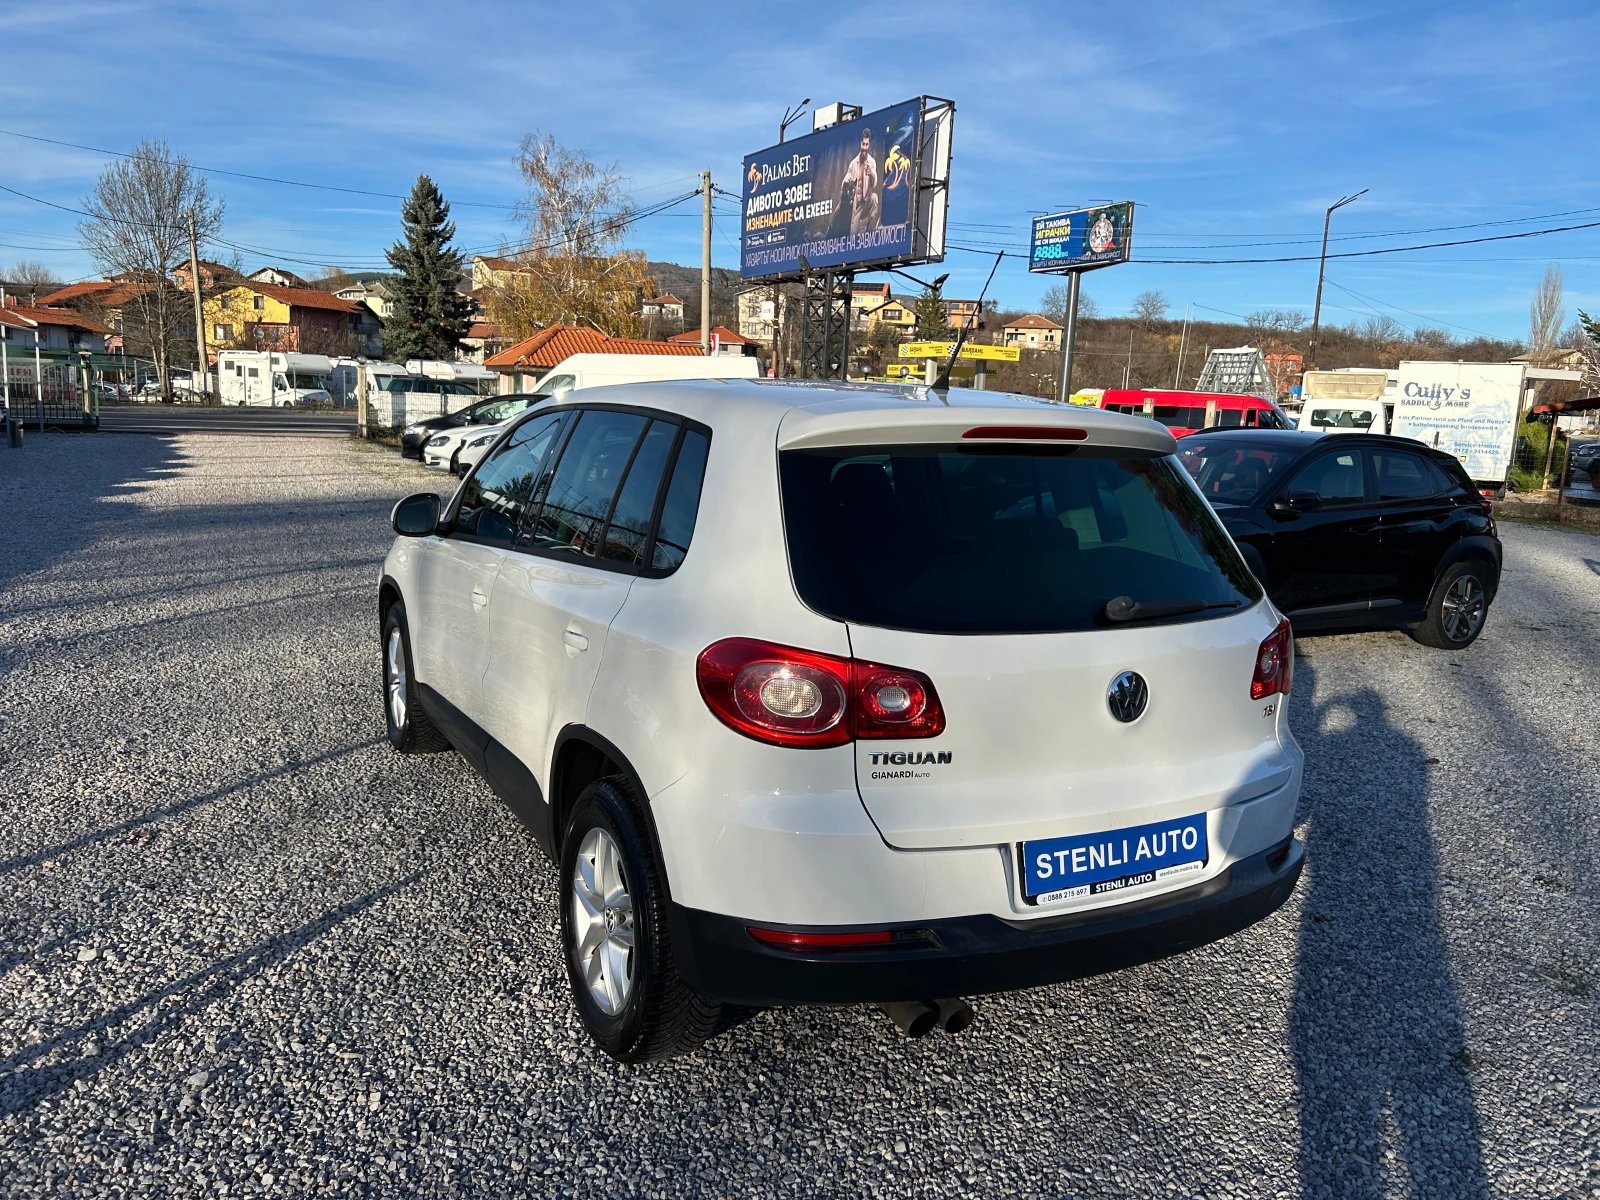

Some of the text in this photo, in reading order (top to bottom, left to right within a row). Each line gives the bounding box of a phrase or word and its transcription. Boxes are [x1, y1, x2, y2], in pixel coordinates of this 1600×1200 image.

[762, 154, 811, 185] PALMS BET
[747, 182, 812, 216] ДИВОТО ЗОВЕ!
[746, 199, 833, 231] ИЗНЕНАДИТЕ СА ЕХЕЕЕ!
[1036, 218, 1070, 230] ЕЙ ТАКИВА
[1036, 226, 1070, 239] ИГРАЧКИ
[745, 250, 771, 267] ХАЗАРТЪТ
[771, 248, 785, 263] НОСИ
[801, 242, 810, 258] ОТ
[810, 236, 846, 258] РАЗВИВАНЕ
[846, 236, 856, 251] НА
[1412, 422, 1459, 430] Sattelanpassung
[1454, 441, 1501, 449] Service-Hotline
[868, 751, 953, 765] TIGUAN
[871, 770, 914, 779] GIANARDI
[1036, 826, 1198, 879] STENLI AUTO
[1096, 873, 1153, 892] STENLI AUTO
[1047, 893, 1062, 902] 0888
